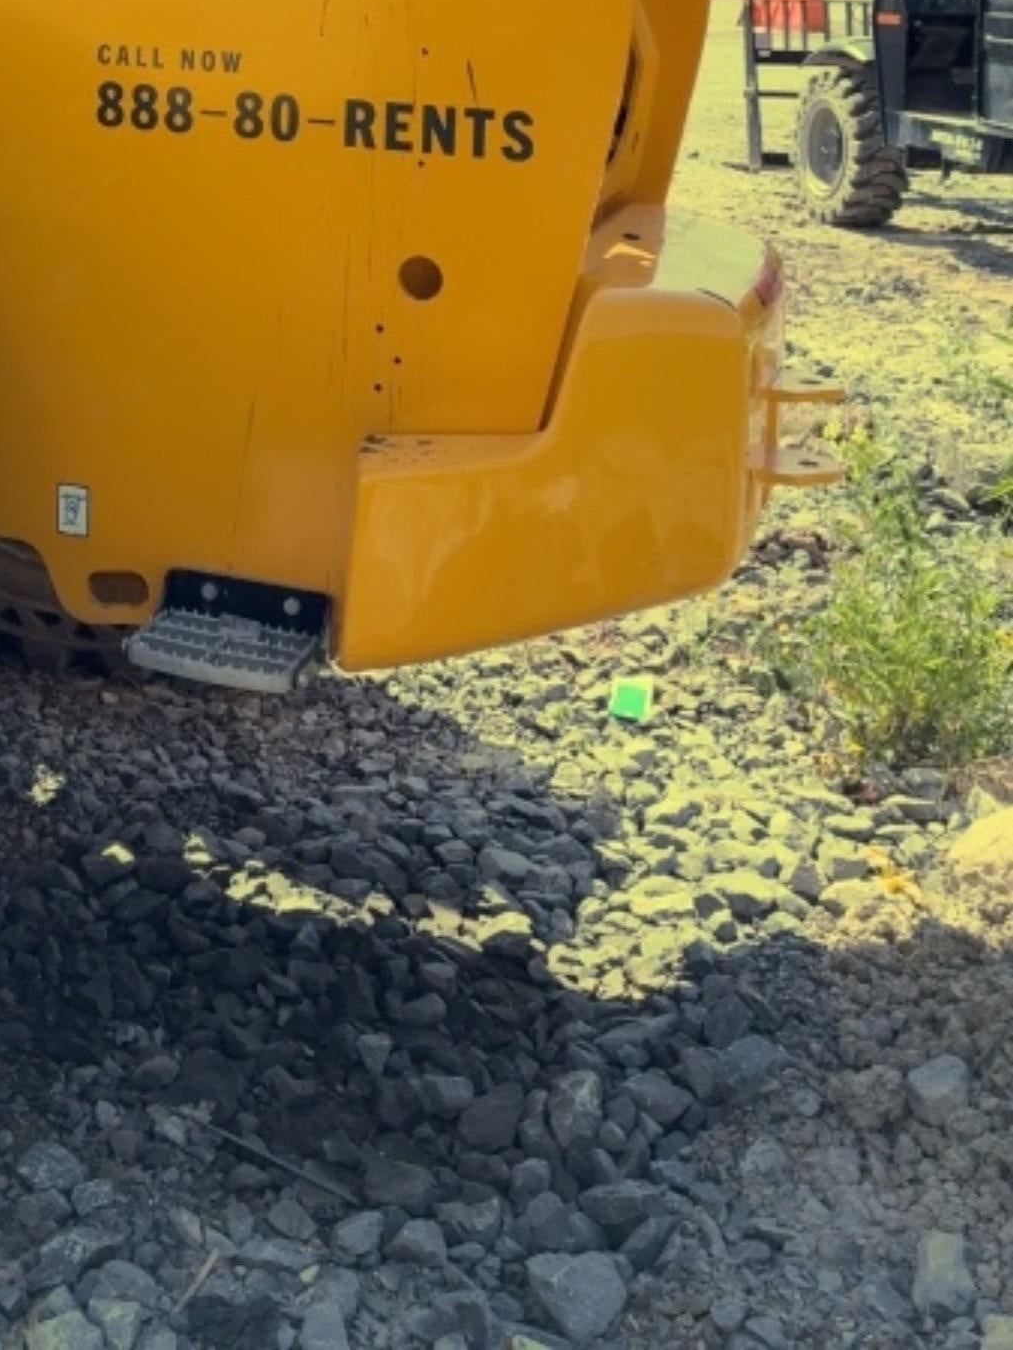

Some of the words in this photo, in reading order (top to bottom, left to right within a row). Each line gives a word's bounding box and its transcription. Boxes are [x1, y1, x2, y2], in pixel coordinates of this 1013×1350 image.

[97, 44, 166, 69] CALL
[181, 50, 243, 74] NOW
[97, 80, 536, 163] 888-80-RENTS
